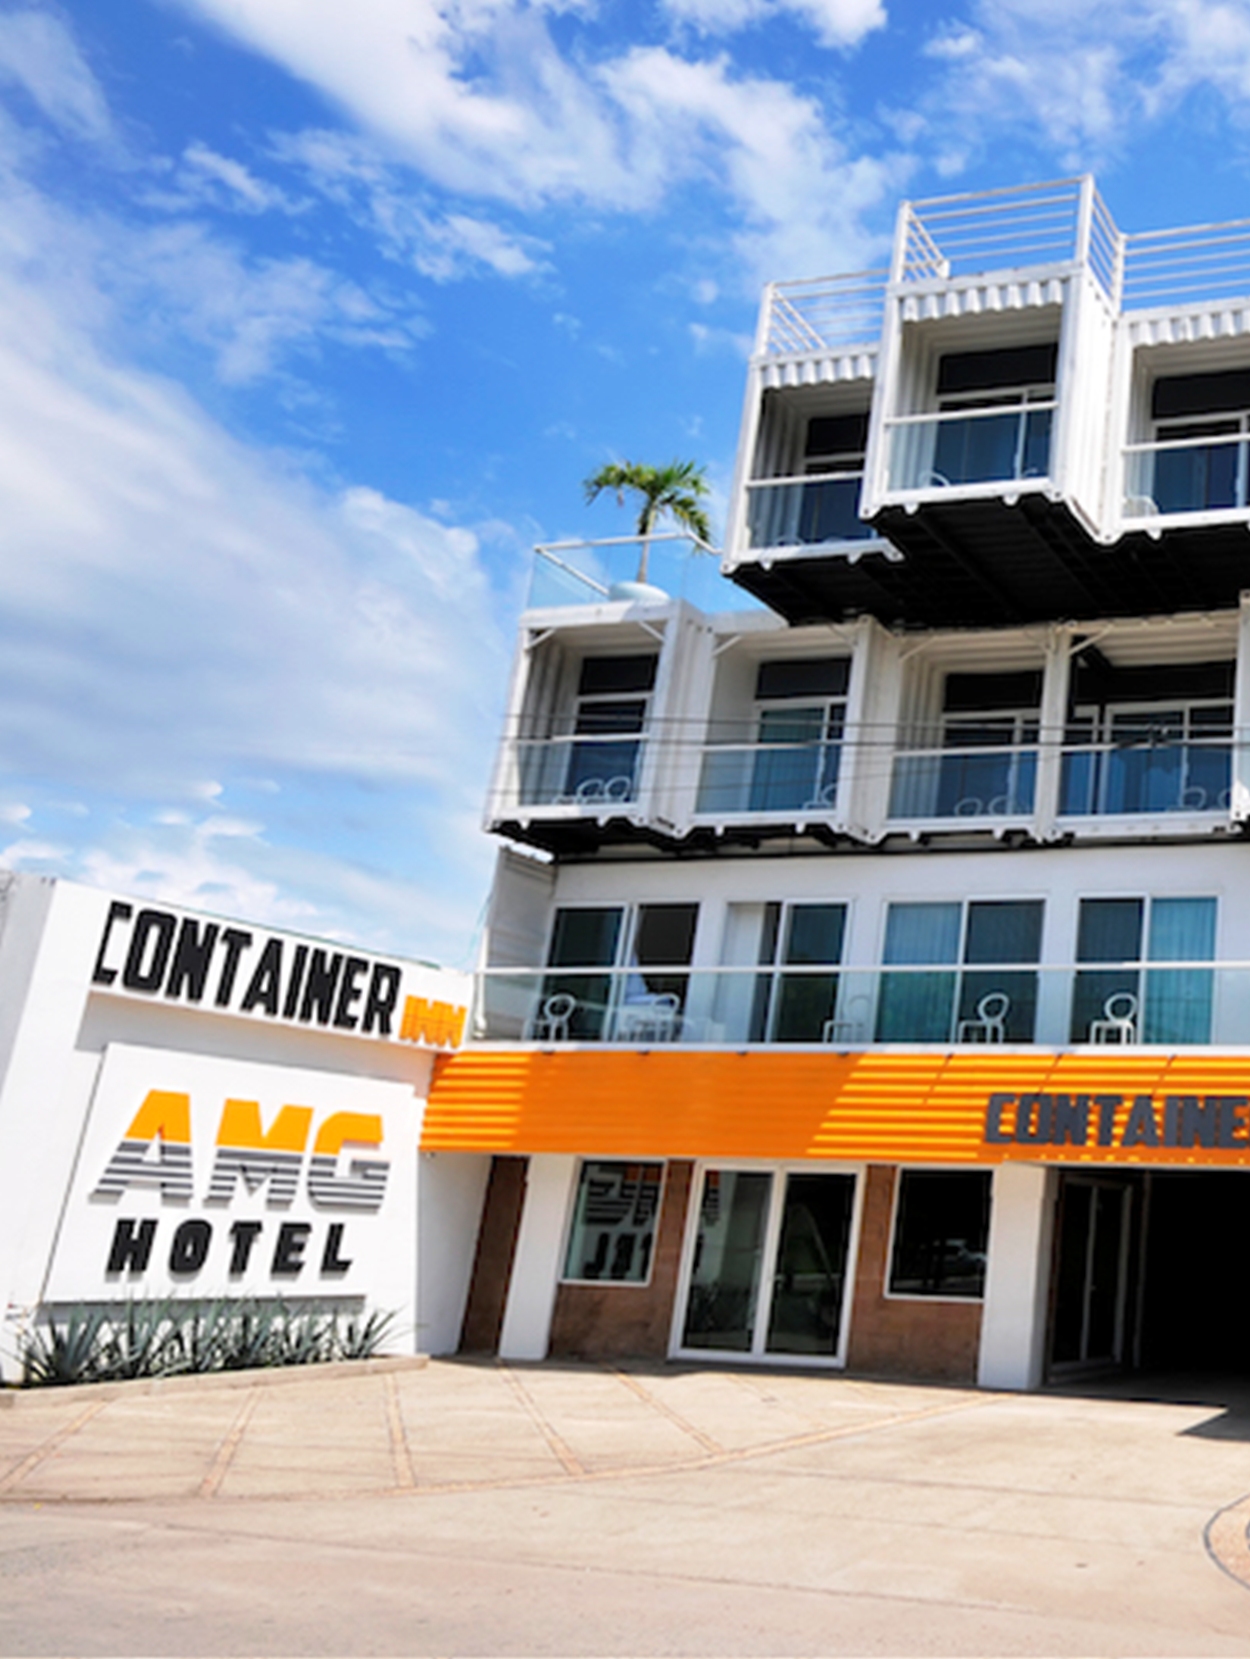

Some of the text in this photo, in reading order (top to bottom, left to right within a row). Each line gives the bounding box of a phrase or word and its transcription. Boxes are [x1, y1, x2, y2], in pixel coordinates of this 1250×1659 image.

[92, 900, 467, 1049] CONTAINER INN
[89, 1089, 390, 1213] AMG
[104, 1218, 353, 1276] HOTEL
